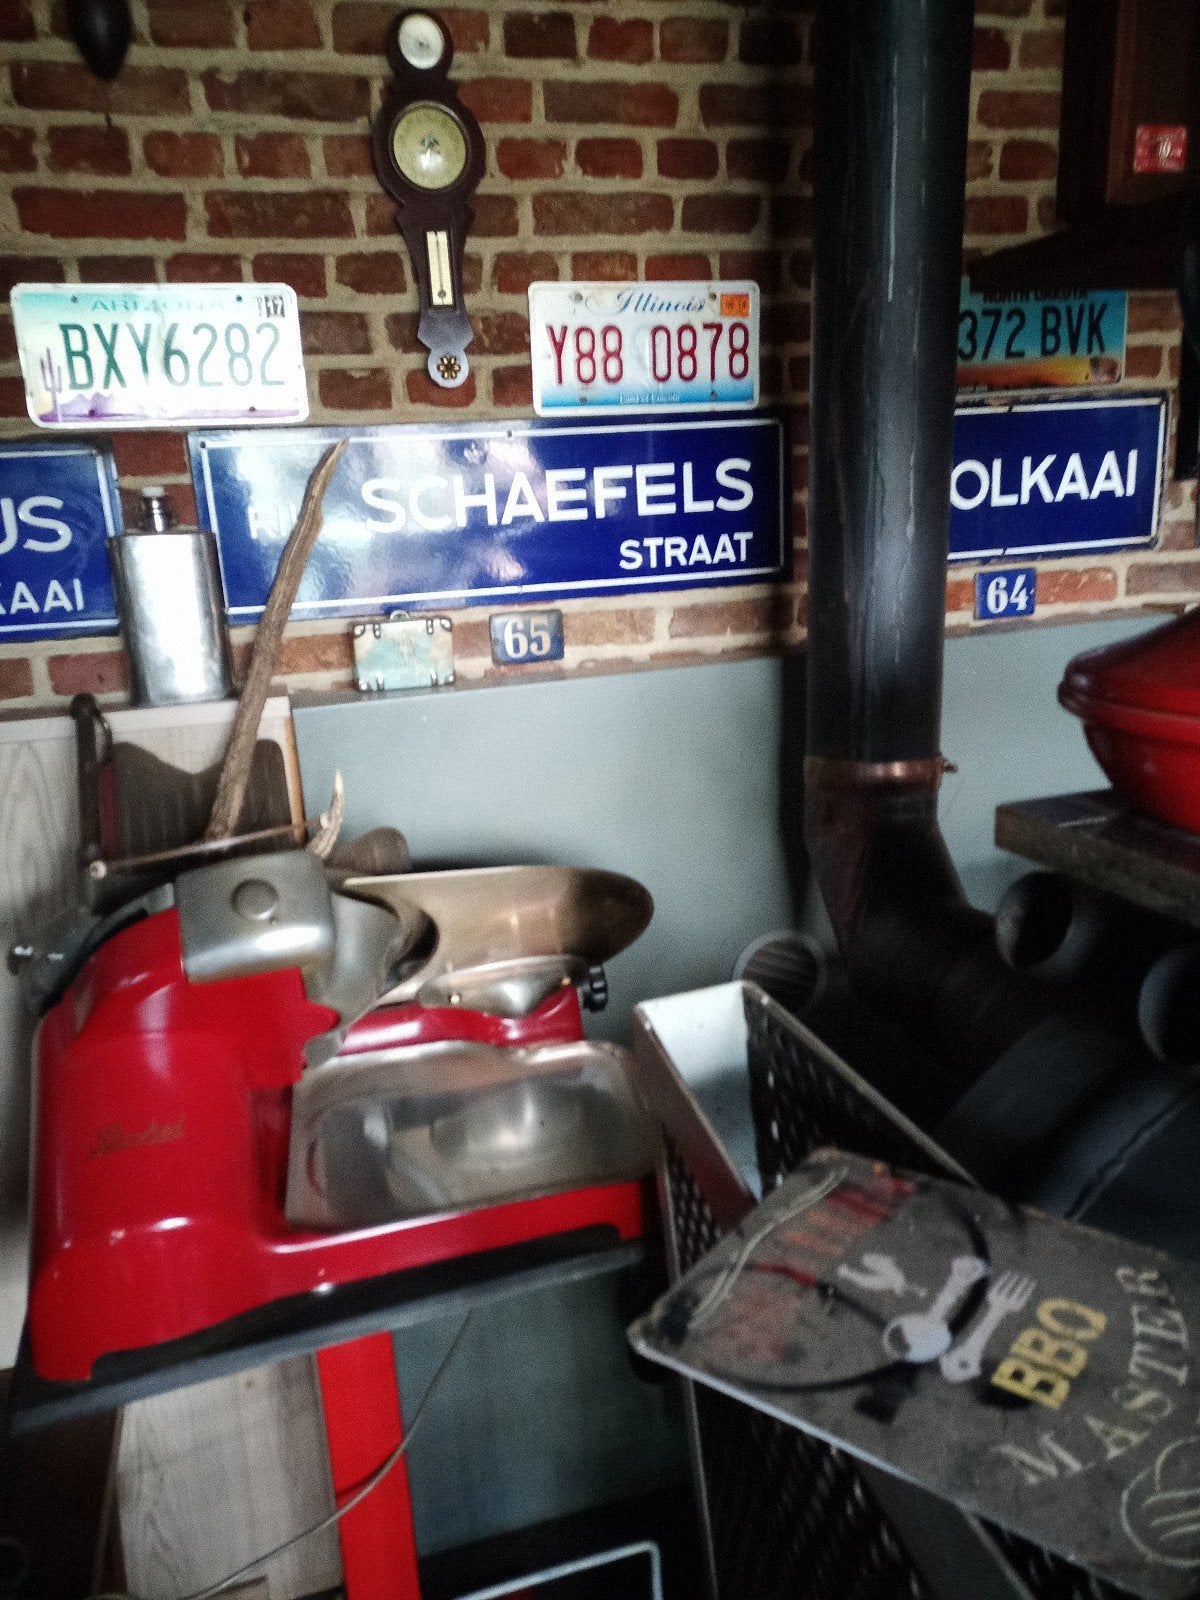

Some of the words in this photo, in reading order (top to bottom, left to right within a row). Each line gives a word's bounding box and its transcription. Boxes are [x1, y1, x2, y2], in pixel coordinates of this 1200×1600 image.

[615, 290, 706, 315] Illinois
[58, 321, 286, 391] BXY6282
[546, 323, 624, 385] Y88
[650, 321, 750, 384] 0878
[957, 306, 1026, 361] 372
[1041, 303, 1109, 357] BVK
[360, 457, 755, 534] SCHAEFELS
[619, 531, 754, 570] STRAAT
[0, 578, 85, 614] AAI
[986, 573, 1029, 614] 64
[503, 613, 552, 659] 65
[989, 1265, 1190, 1486] MASTER
[991, 1297, 1109, 1411] BBQ
